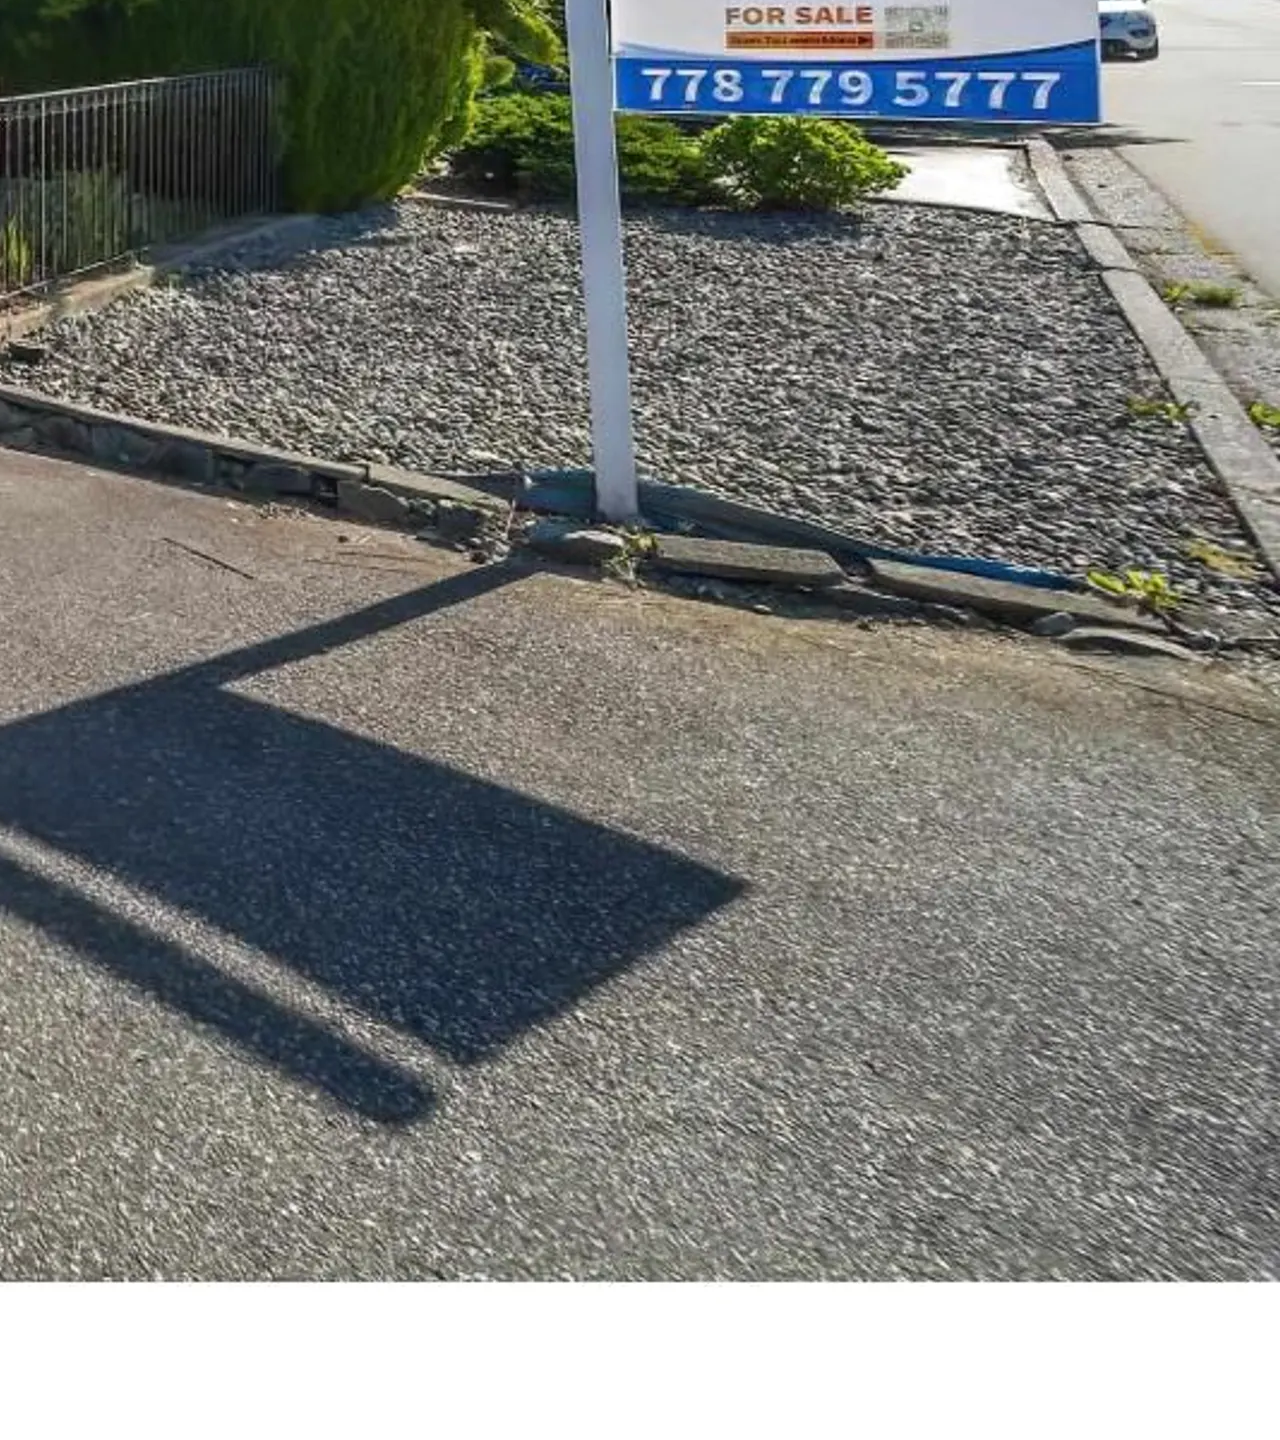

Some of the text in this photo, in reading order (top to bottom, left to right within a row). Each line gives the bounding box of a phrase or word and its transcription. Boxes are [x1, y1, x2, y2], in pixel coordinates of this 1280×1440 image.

[725, 6, 873, 25] FOR SALE
[641, 68, 1061, 111] 778 779 5777
